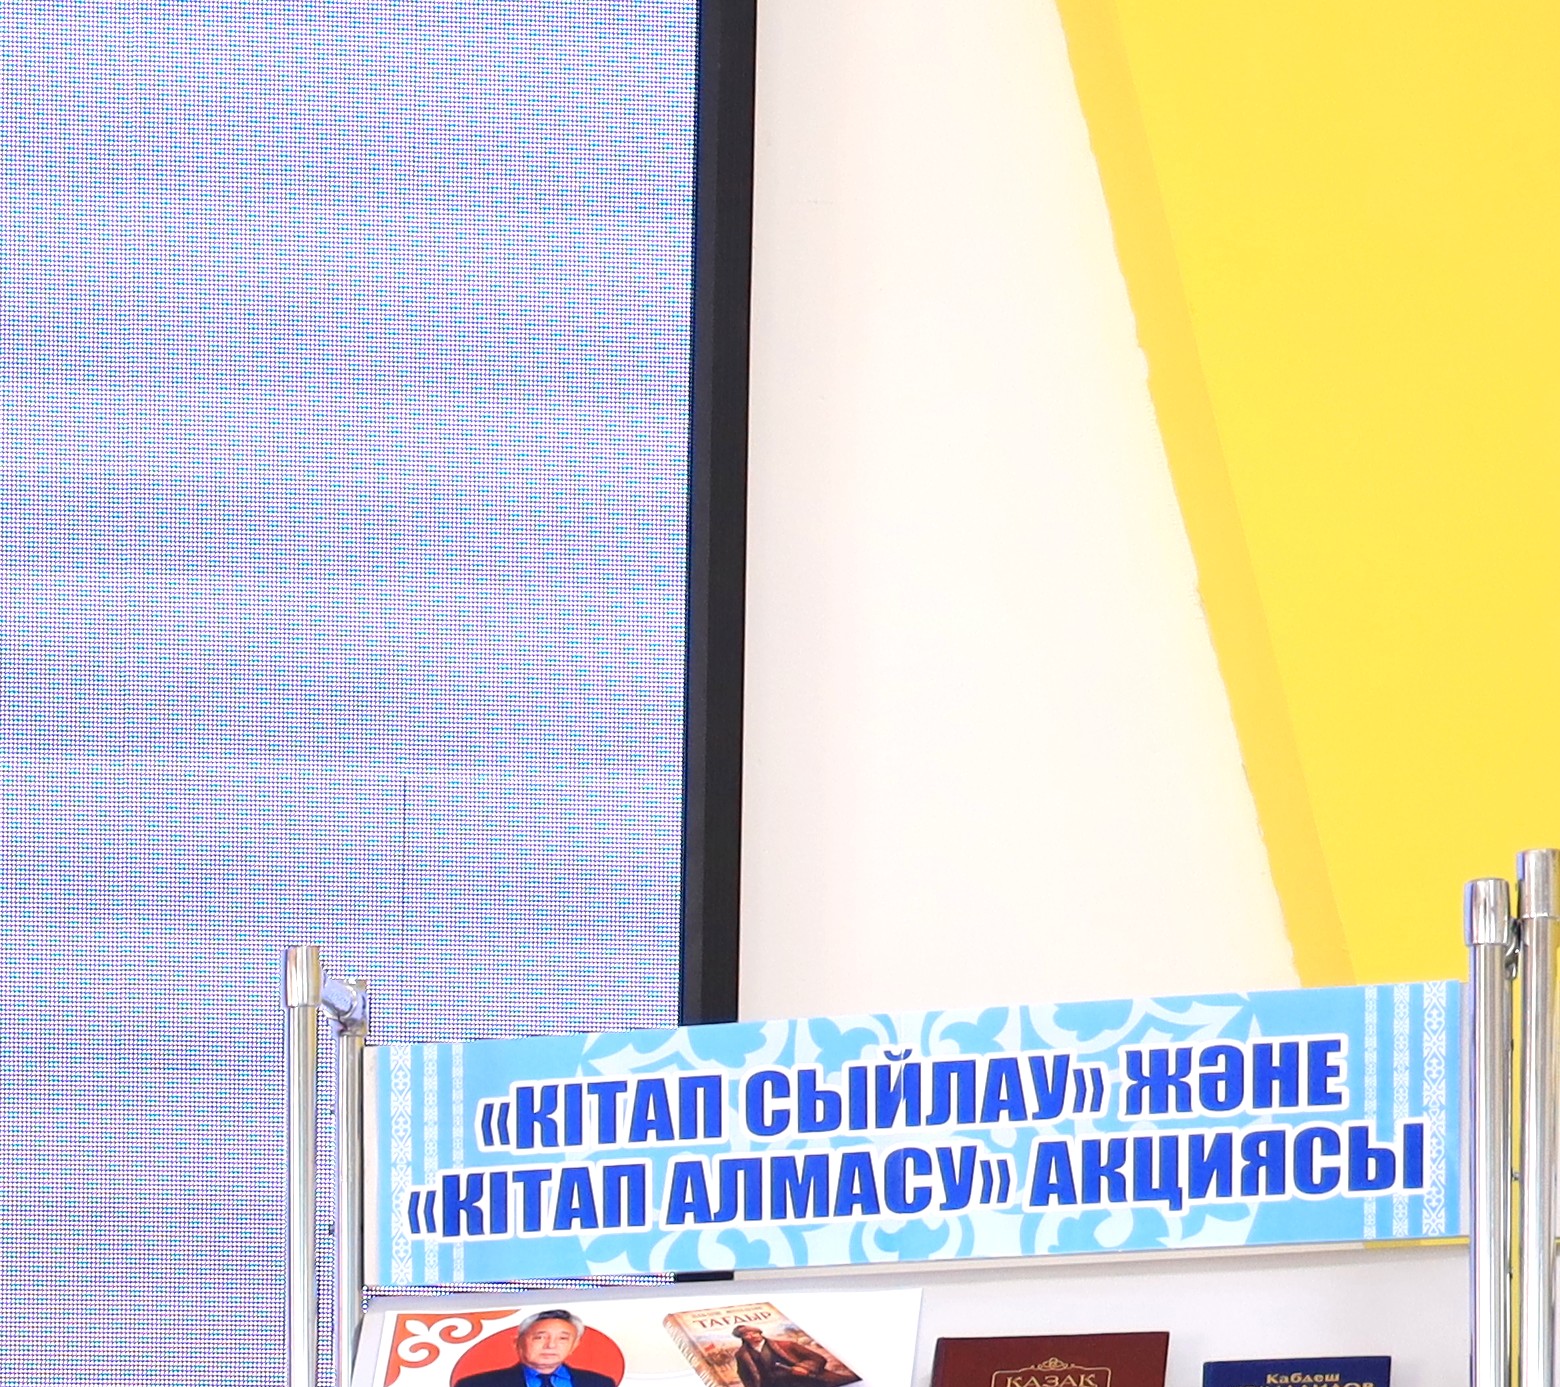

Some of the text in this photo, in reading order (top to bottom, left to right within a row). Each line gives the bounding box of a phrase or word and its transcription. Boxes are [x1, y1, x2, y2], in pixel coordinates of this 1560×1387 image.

[481, 1039, 1342, 1149] «КІТАП СЫЙЛАУ» ЖӘНЕ
[407, 1123, 1425, 1236] «КІТАП АЛМАСУ» АКЦИЯСЫ
